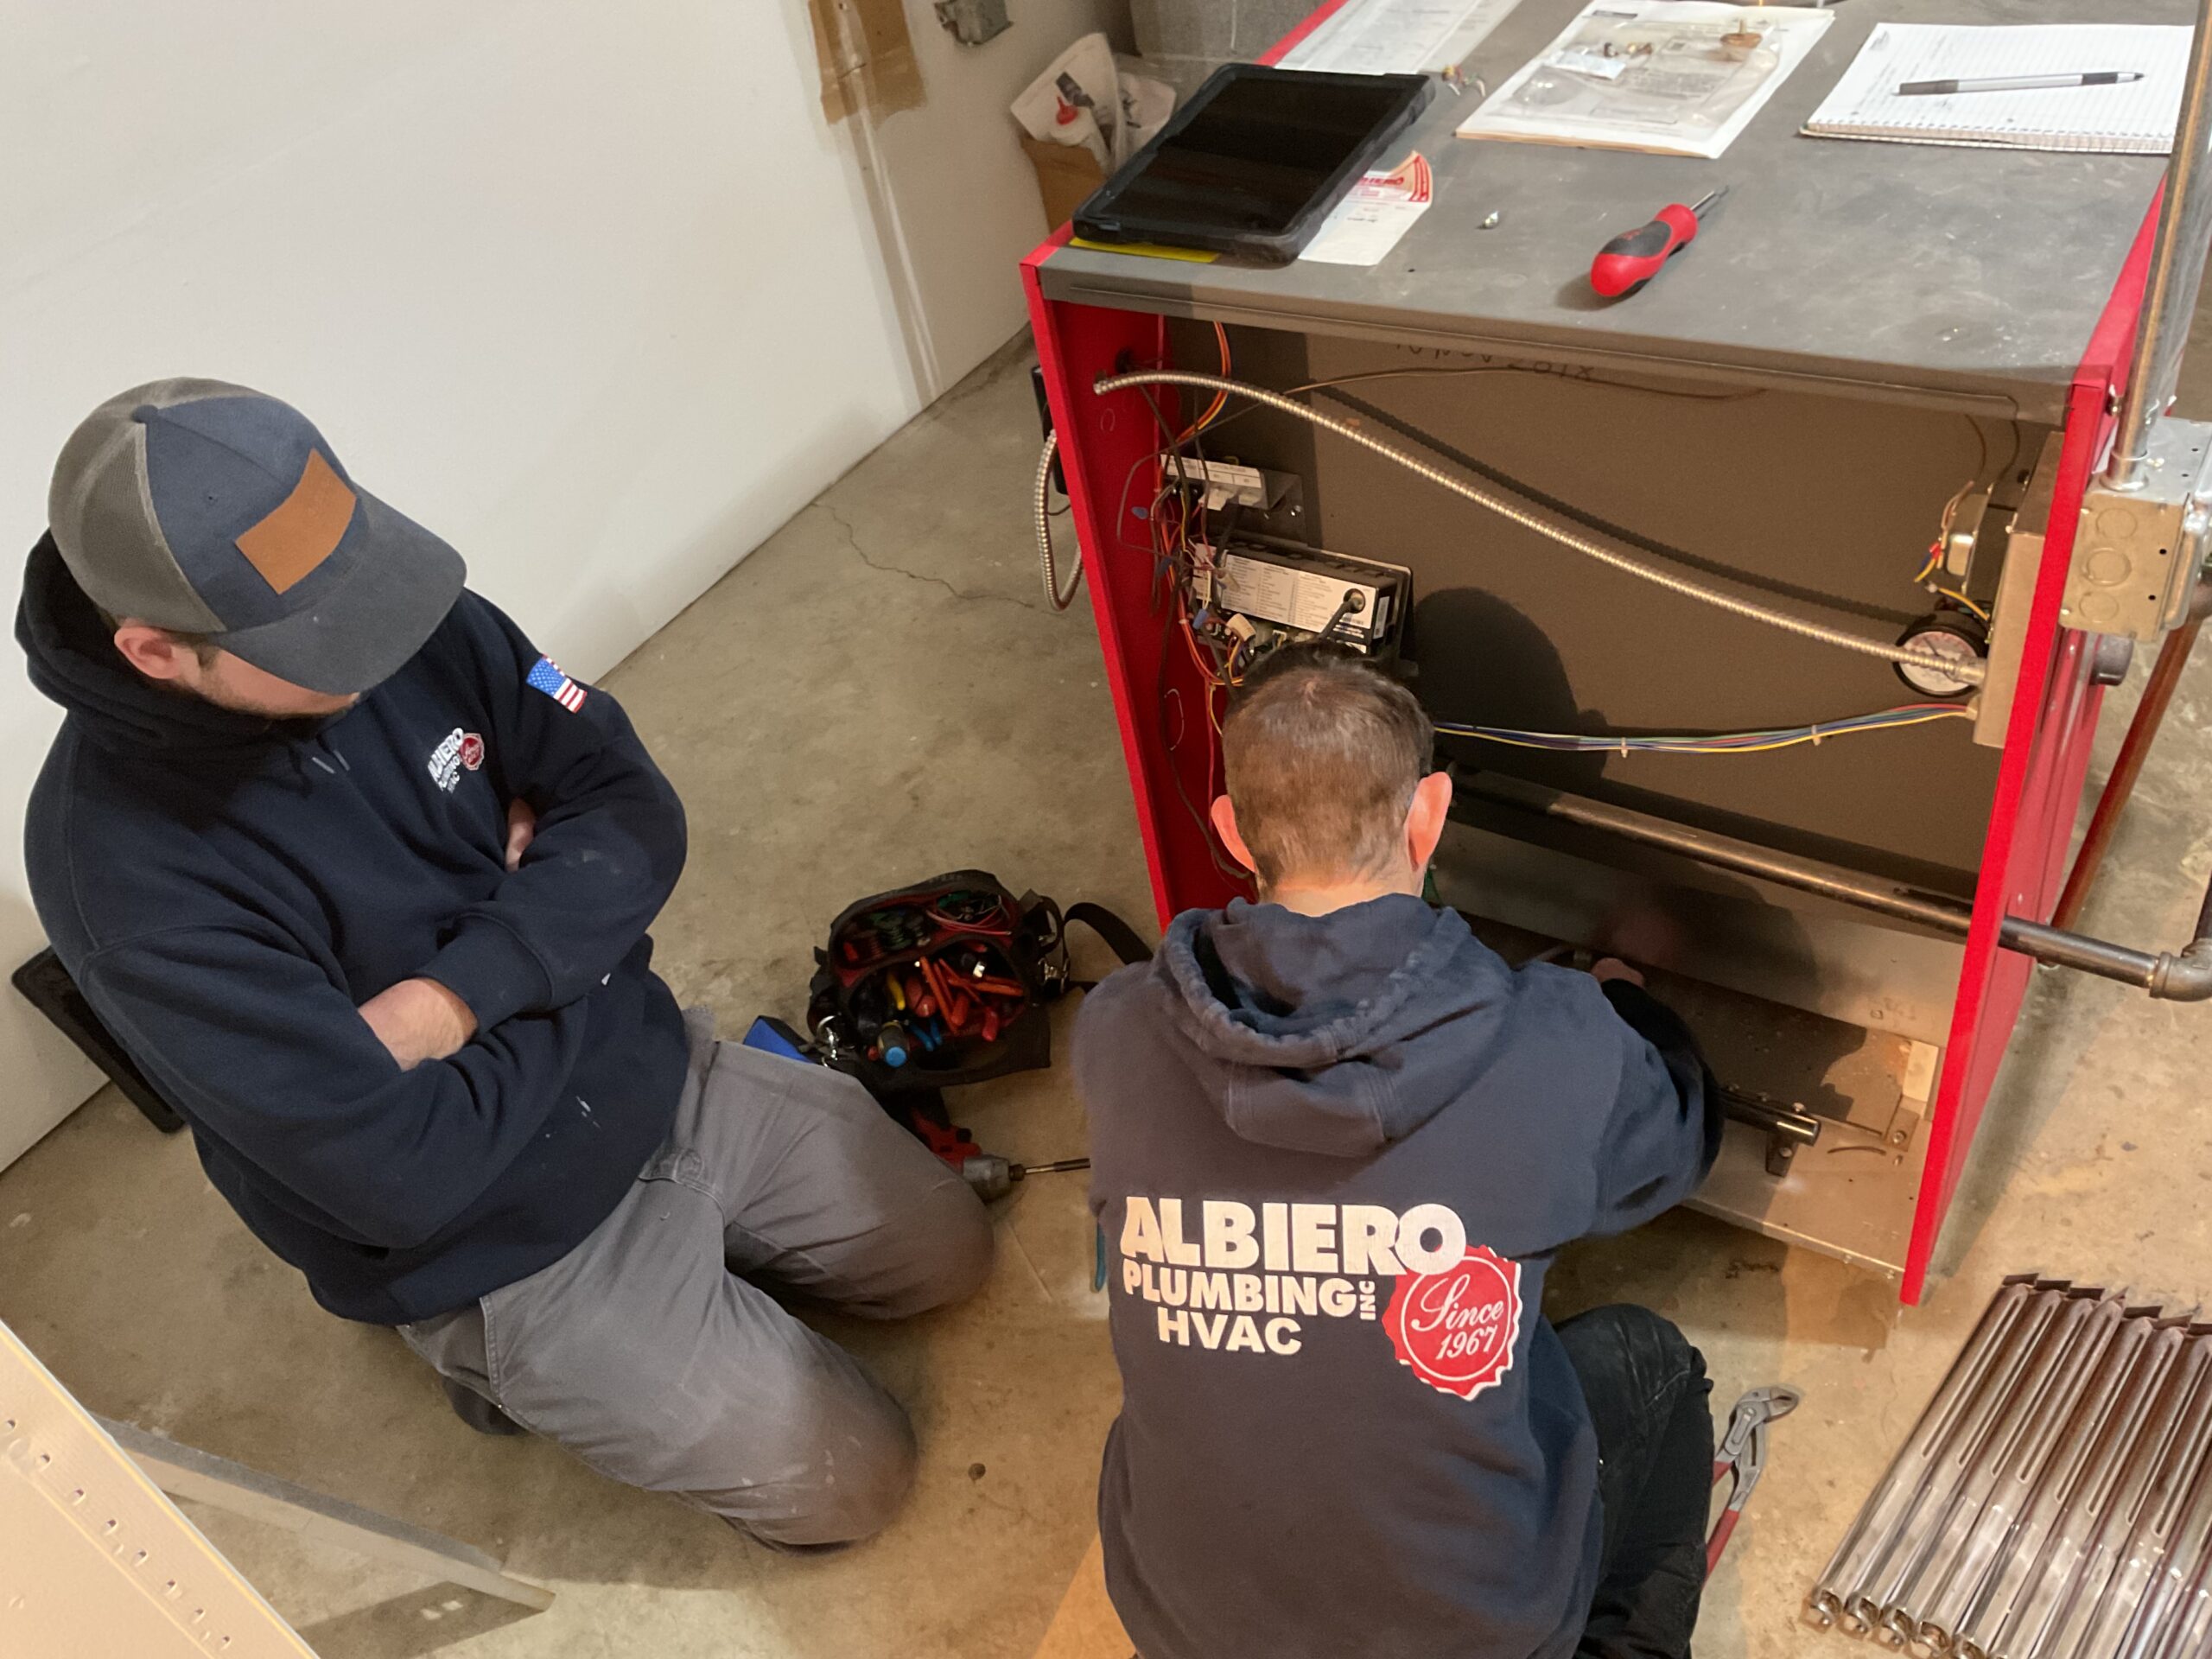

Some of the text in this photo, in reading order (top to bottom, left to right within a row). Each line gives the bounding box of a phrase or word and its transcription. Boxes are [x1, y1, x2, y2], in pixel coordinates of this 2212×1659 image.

[1120, 1196, 1466, 1275] ALBIERO
[1123, 1258, 1376, 1320] PLUMBING INC
[1411, 1273, 1504, 1331] Since
[1157, 1306, 1302, 1356] HVAC
[1435, 1325, 1498, 1360] 1967
